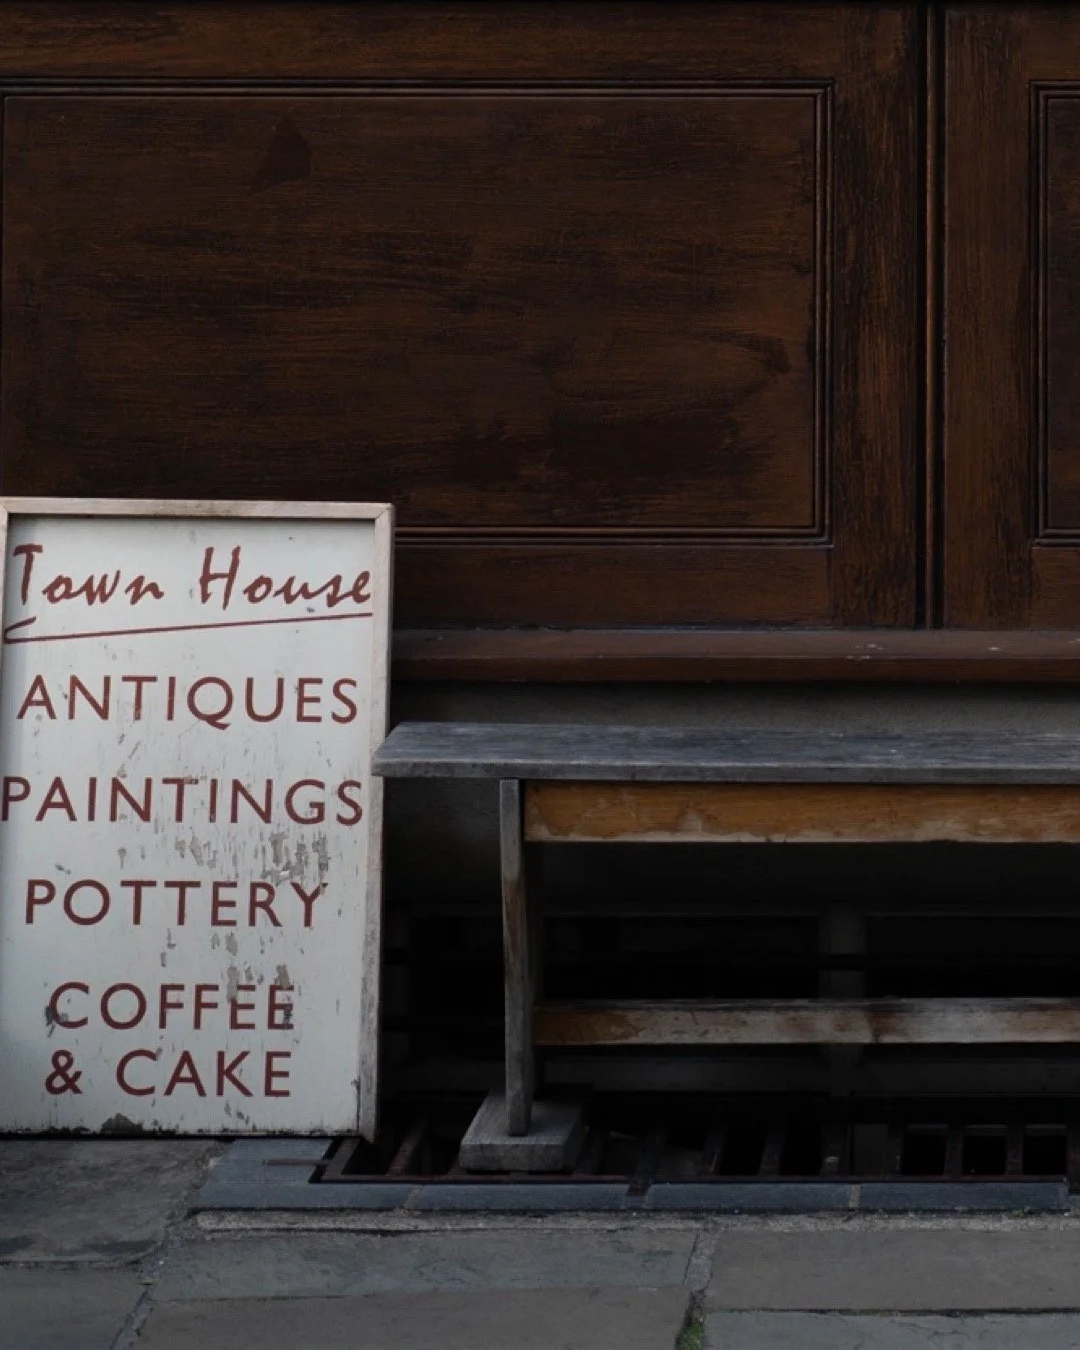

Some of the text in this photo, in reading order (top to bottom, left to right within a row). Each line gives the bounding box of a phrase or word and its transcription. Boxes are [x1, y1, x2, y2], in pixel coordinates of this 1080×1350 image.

[13, 543, 371, 610] Town House
[17, 675, 358, 730] ANTIQUES
[0, 777, 364, 826] PAINTINGS
[25, 880, 328, 927] POTTERY
[46, 983, 294, 1031] COFFEE
[45, 1050, 292, 1098] & CAKE
